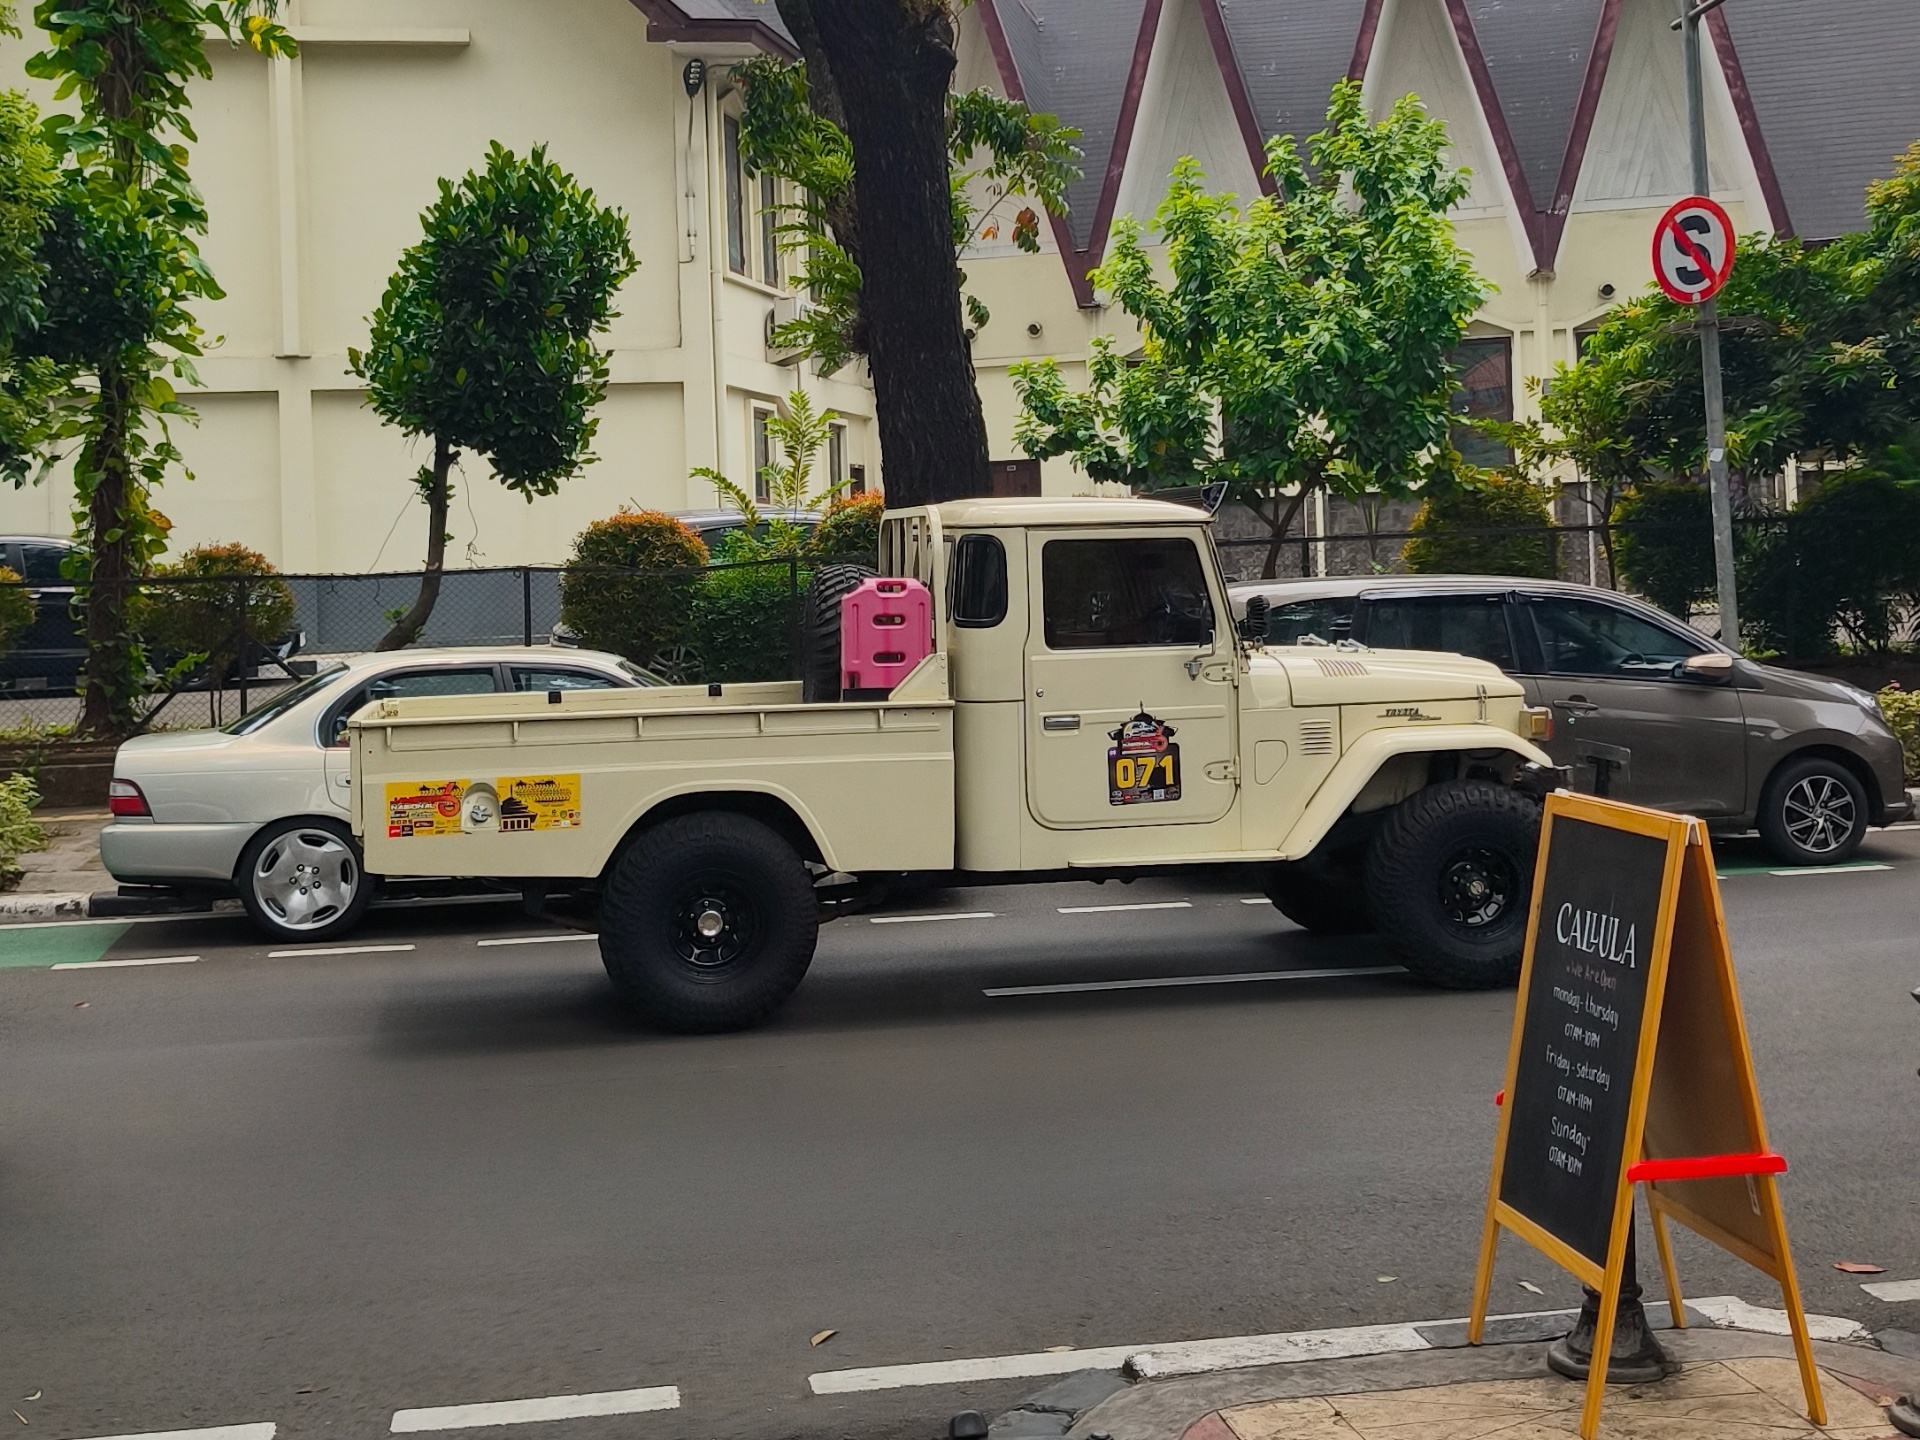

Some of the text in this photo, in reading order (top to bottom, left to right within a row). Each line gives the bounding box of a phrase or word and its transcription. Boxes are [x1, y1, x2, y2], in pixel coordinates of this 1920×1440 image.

[1673, 214, 1712, 285] S
[1116, 755, 1175, 789] 071
[1556, 902, 1636, 968] CALLULA
